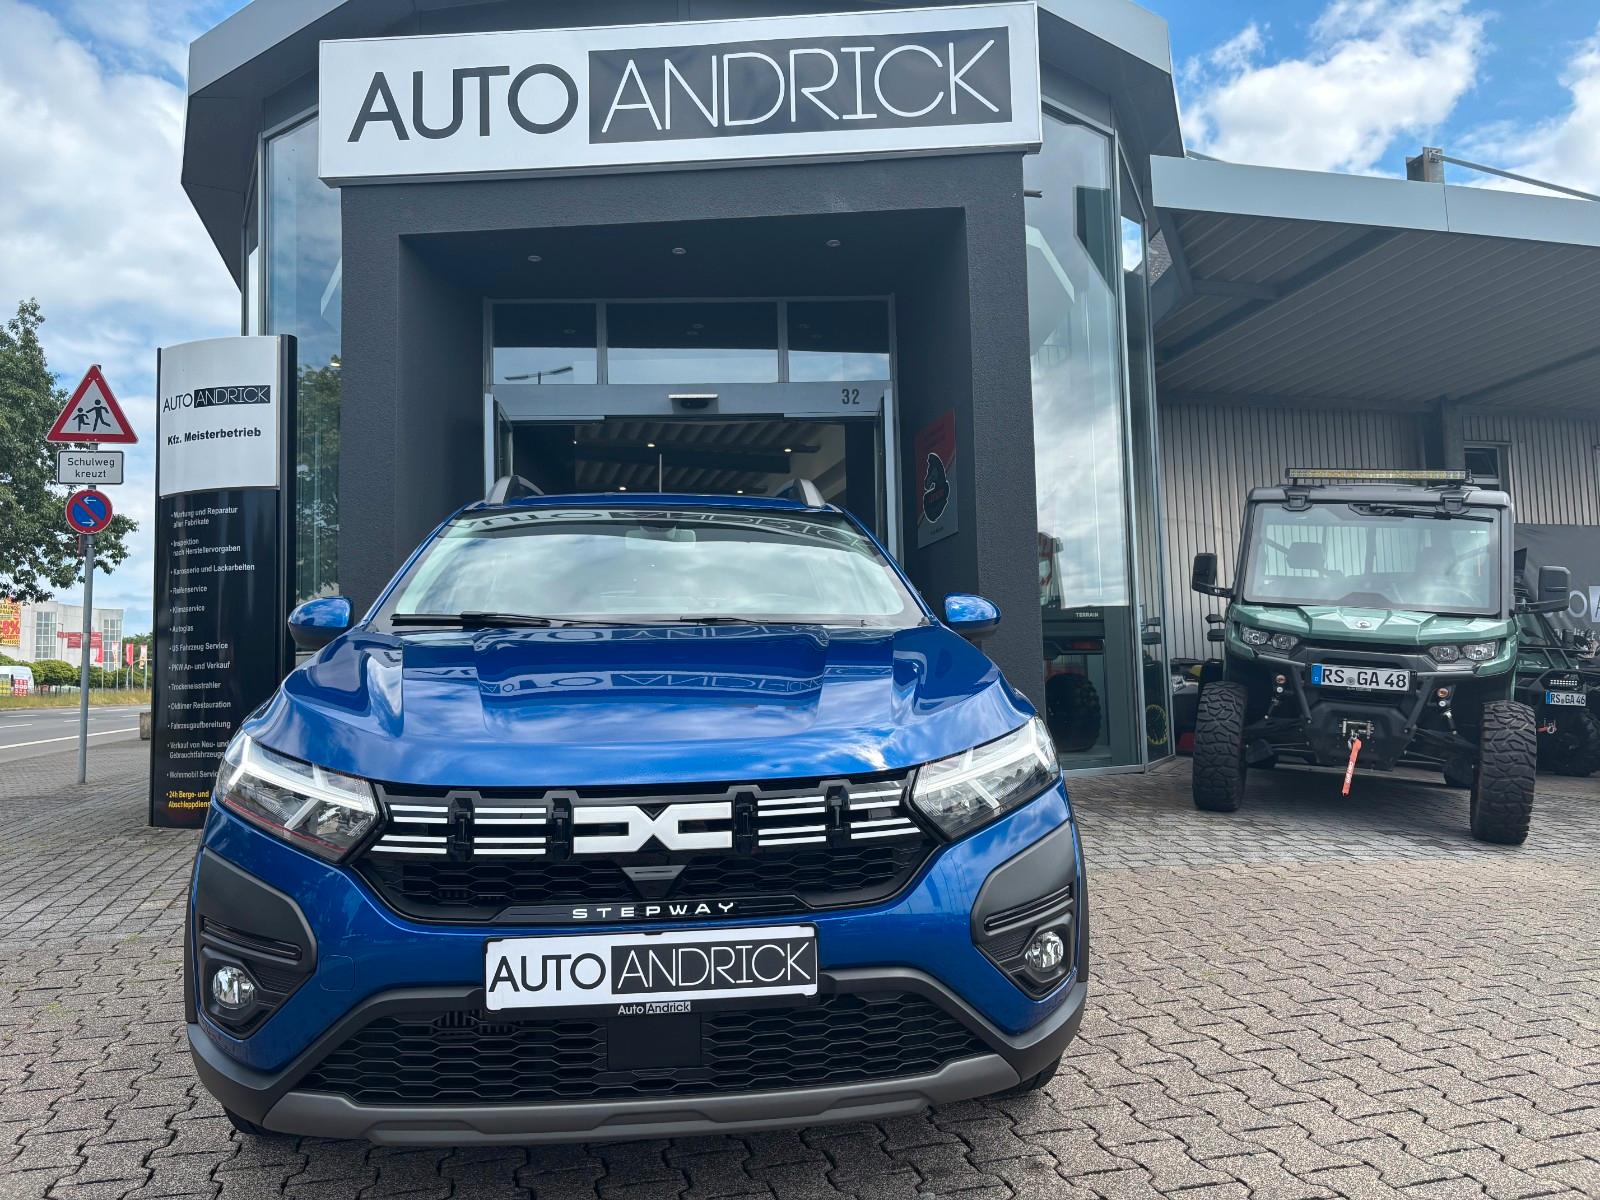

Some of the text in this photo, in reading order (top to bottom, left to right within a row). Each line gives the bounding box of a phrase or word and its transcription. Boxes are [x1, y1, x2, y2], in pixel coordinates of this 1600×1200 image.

[347, 39, 1000, 143] AUTO ANDRICK
[163, 386, 269, 413] AUTO ANDRICK
[842, 389, 860, 404] 32
[167, 427, 262, 446] Kfz. Meisterbetrieb
[67, 458, 115, 468] Schulweg
[75, 470, 107, 478] kreuzt
[207, 507, 239, 516] Reparatur
[185, 544, 241, 555] Herstellervorgaben
[200, 564, 213, 573] und
[213, 563, 255, 572] Lackarbeiten
[205, 642, 229, 650] Service
[206, 661, 231, 669] Verkauf
[1322, 668, 1407, 689] RS GA 48
[192, 700, 232, 709] Restauration
[1551, 693, 1586, 705] RS GA 46
[199, 770, 218, 778] Servic
[168, 800, 211, 809] Abschleppdiens
[572, 902, 735, 920] STEPWAY
[488, 941, 811, 993] AUTO ANDRICK
[618, 1001, 690, 1015] Auto Andrick
